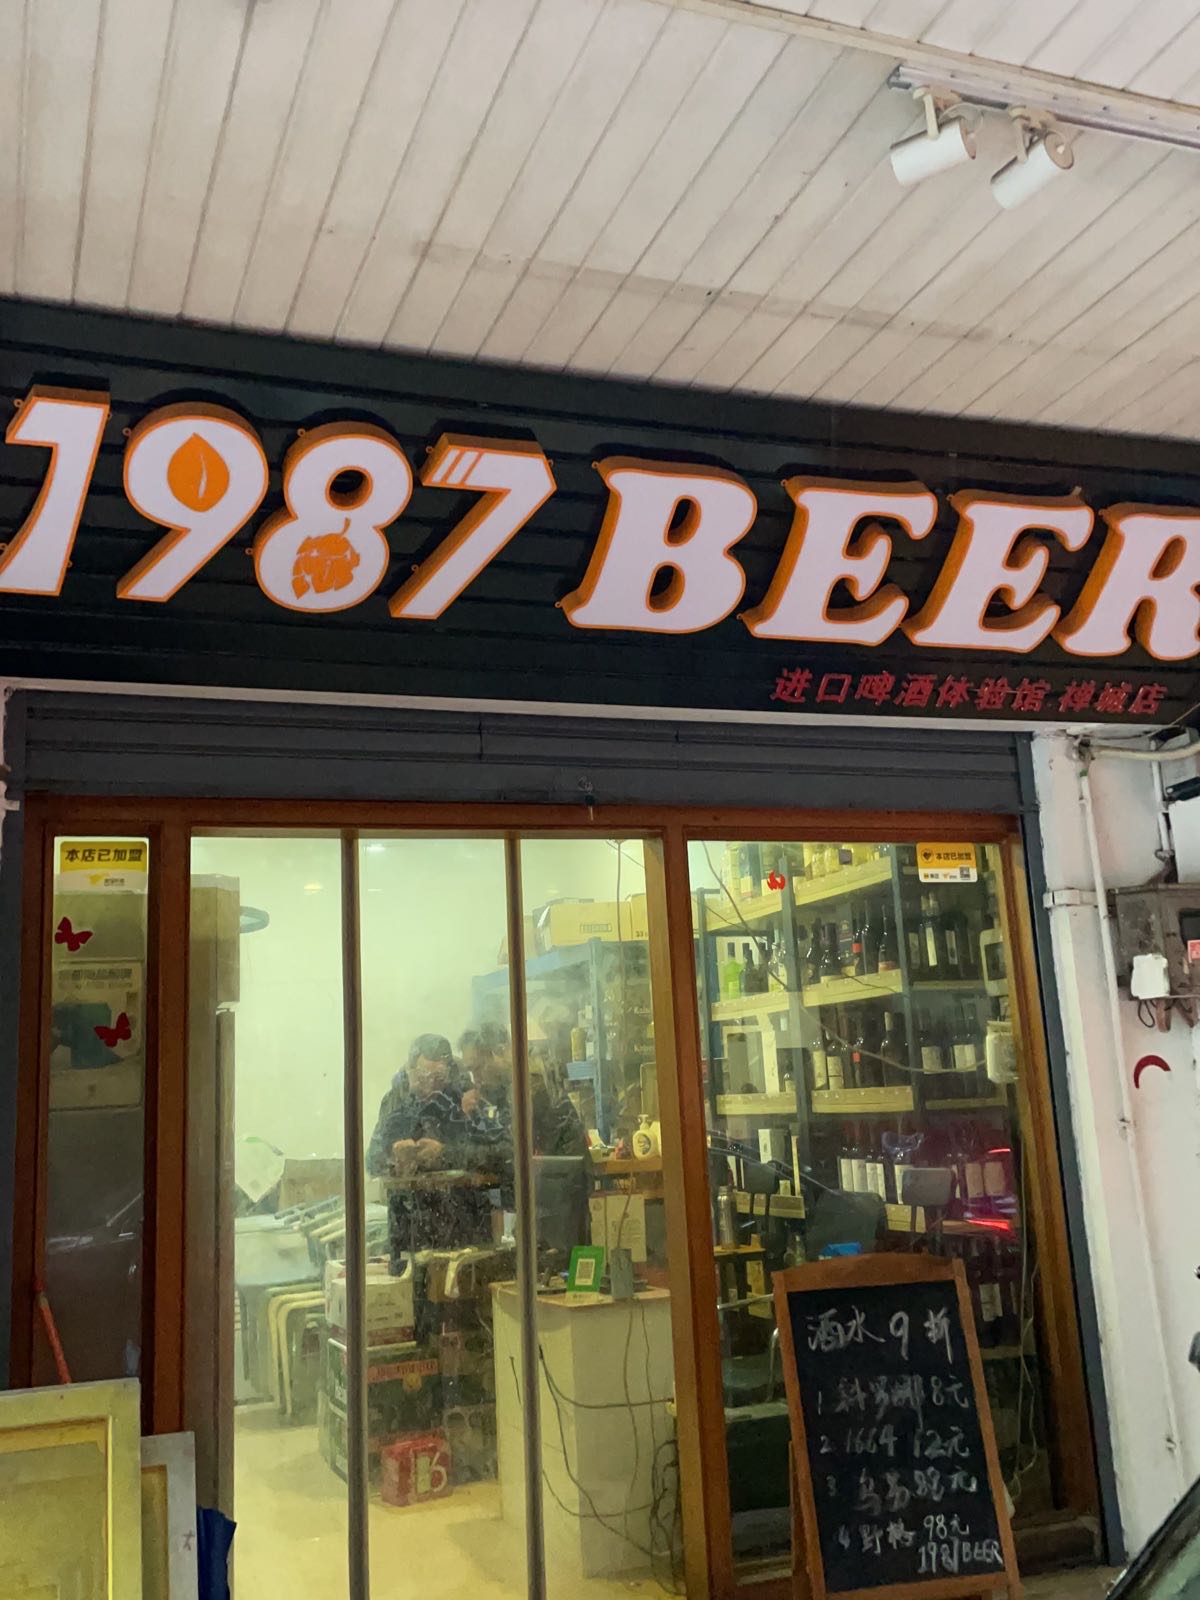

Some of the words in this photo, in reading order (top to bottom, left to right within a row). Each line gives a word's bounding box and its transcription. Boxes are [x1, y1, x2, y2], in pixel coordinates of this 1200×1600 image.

[0, 385, 557, 619] 1987
[562, 456, 1200, 661] BEER
[65, 848, 142, 862] 本店已加盟
